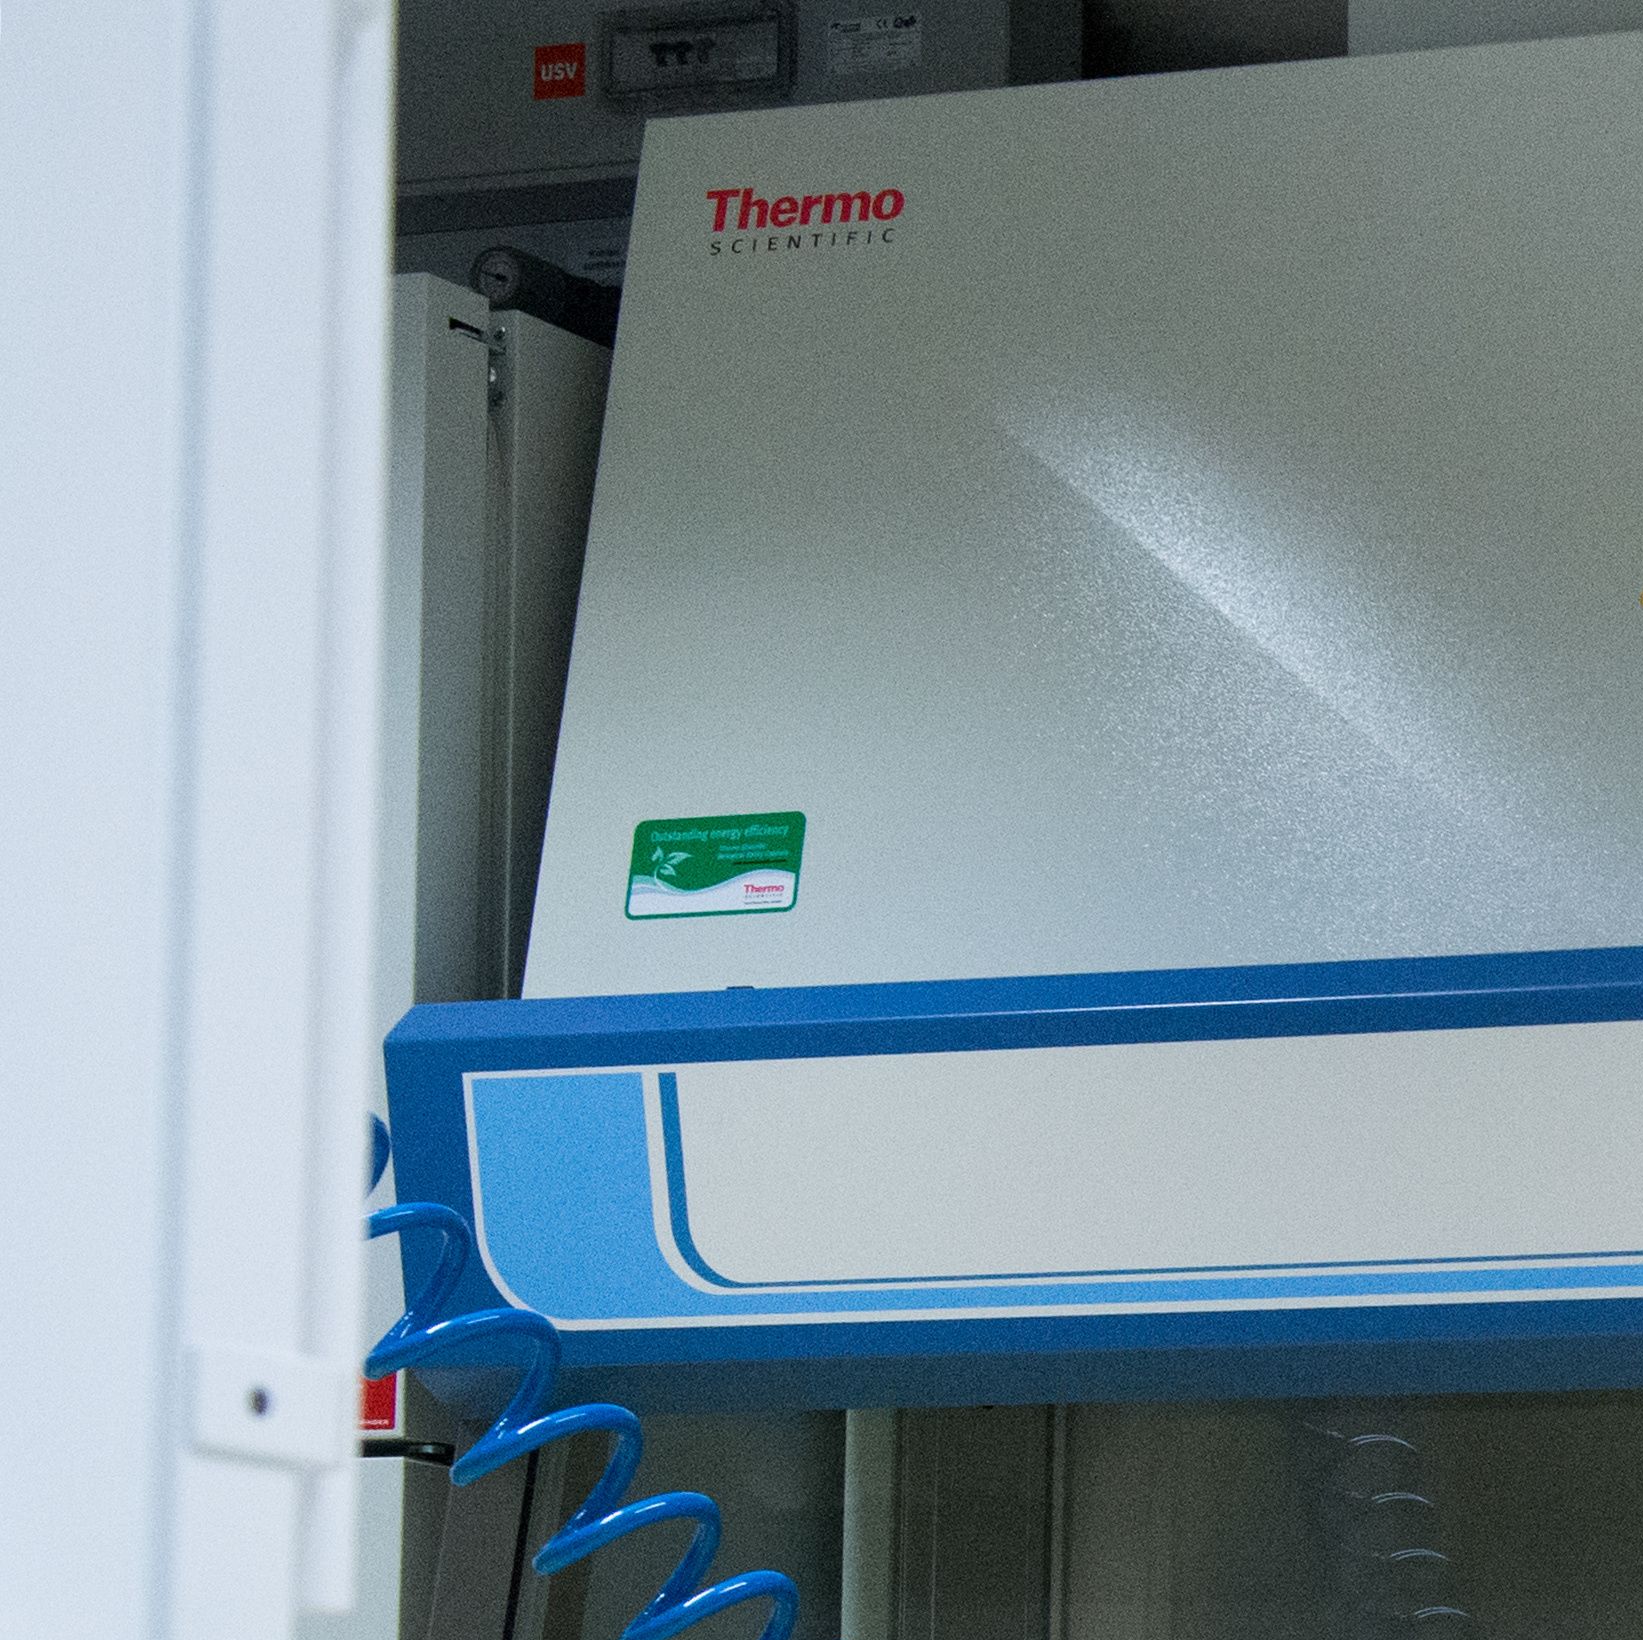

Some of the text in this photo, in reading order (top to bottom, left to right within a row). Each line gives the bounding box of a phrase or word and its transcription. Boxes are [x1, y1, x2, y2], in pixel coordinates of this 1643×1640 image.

[541, 62, 577, 81] USV
[706, 187, 905, 232] Thermo
[710, 228, 896, 256] SCIENTIFIC
[651, 825, 789, 843] Outstanding energy efficiency
[744, 884, 785, 895] Thermo
